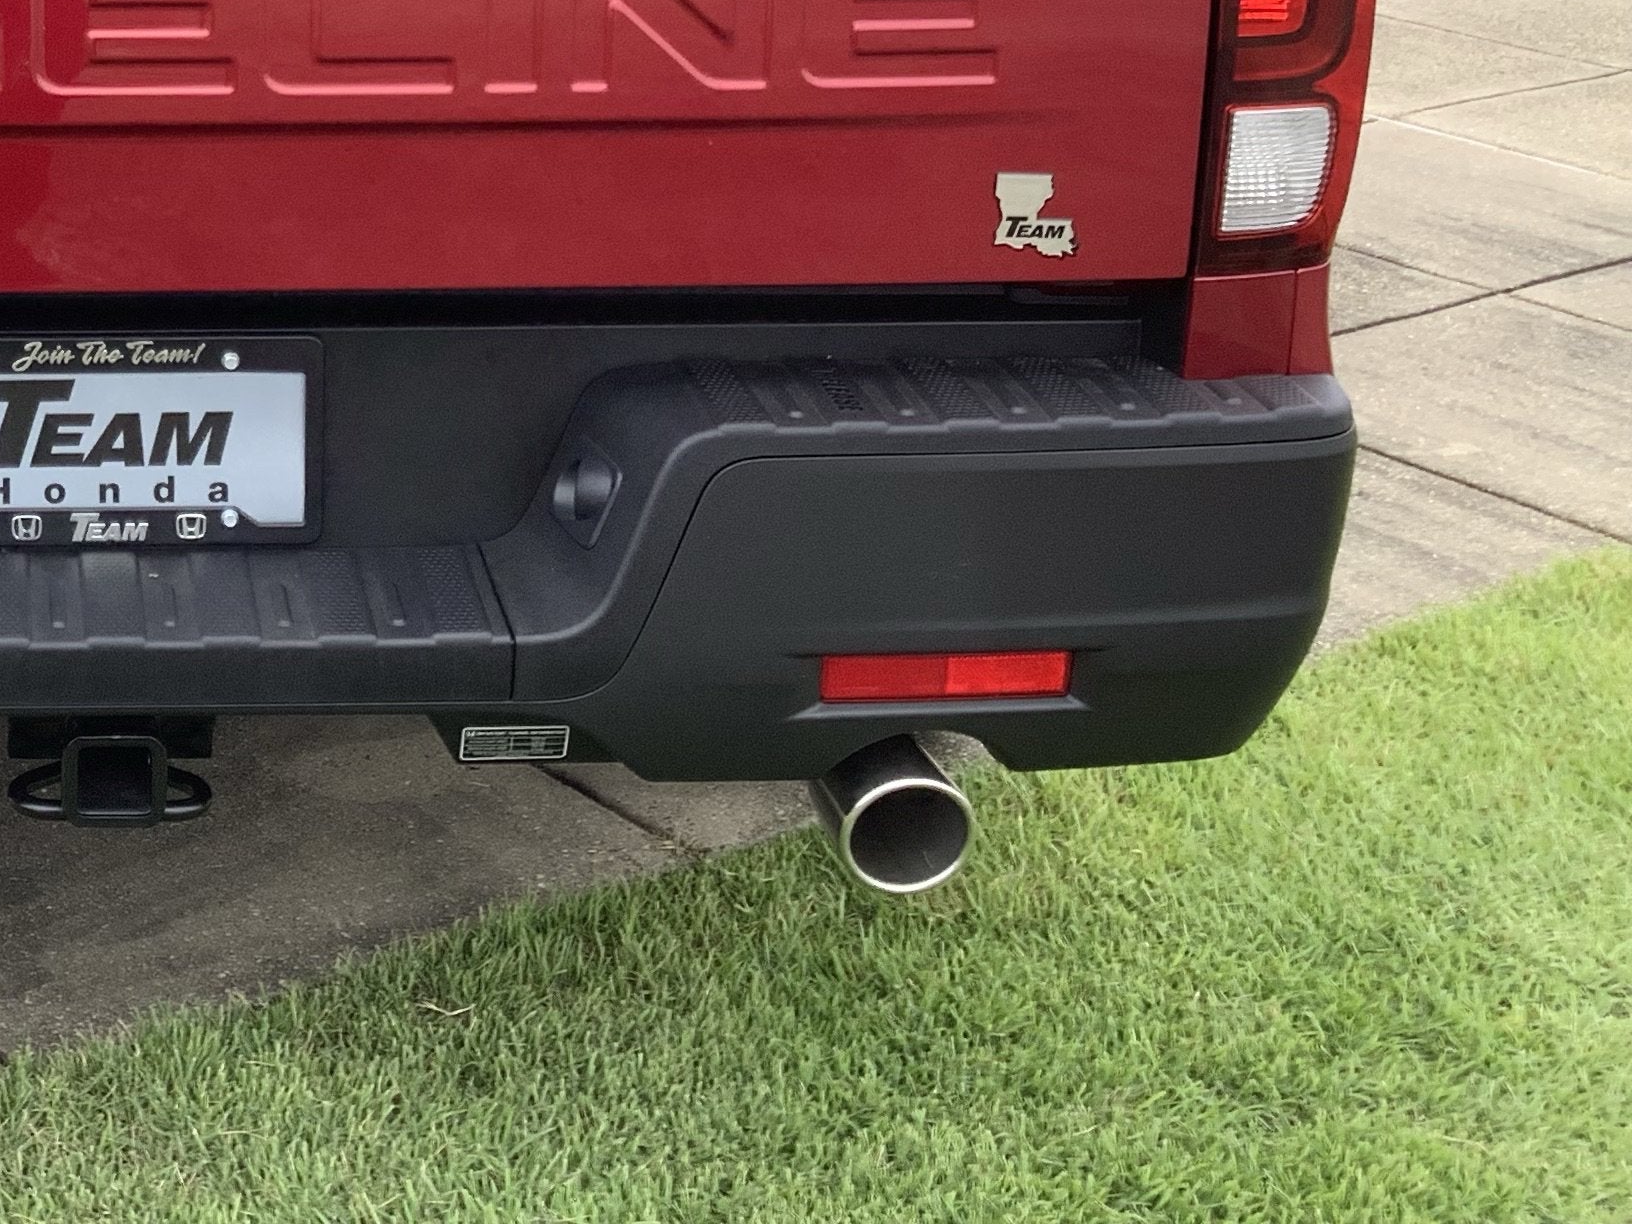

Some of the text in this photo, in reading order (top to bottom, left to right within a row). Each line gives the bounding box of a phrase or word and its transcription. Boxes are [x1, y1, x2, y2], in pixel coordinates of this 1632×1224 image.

[1005, 216, 1066, 239] TEAM
[12, 340, 206, 372] Join The Team!
[69, 512, 150, 543] TEAM
